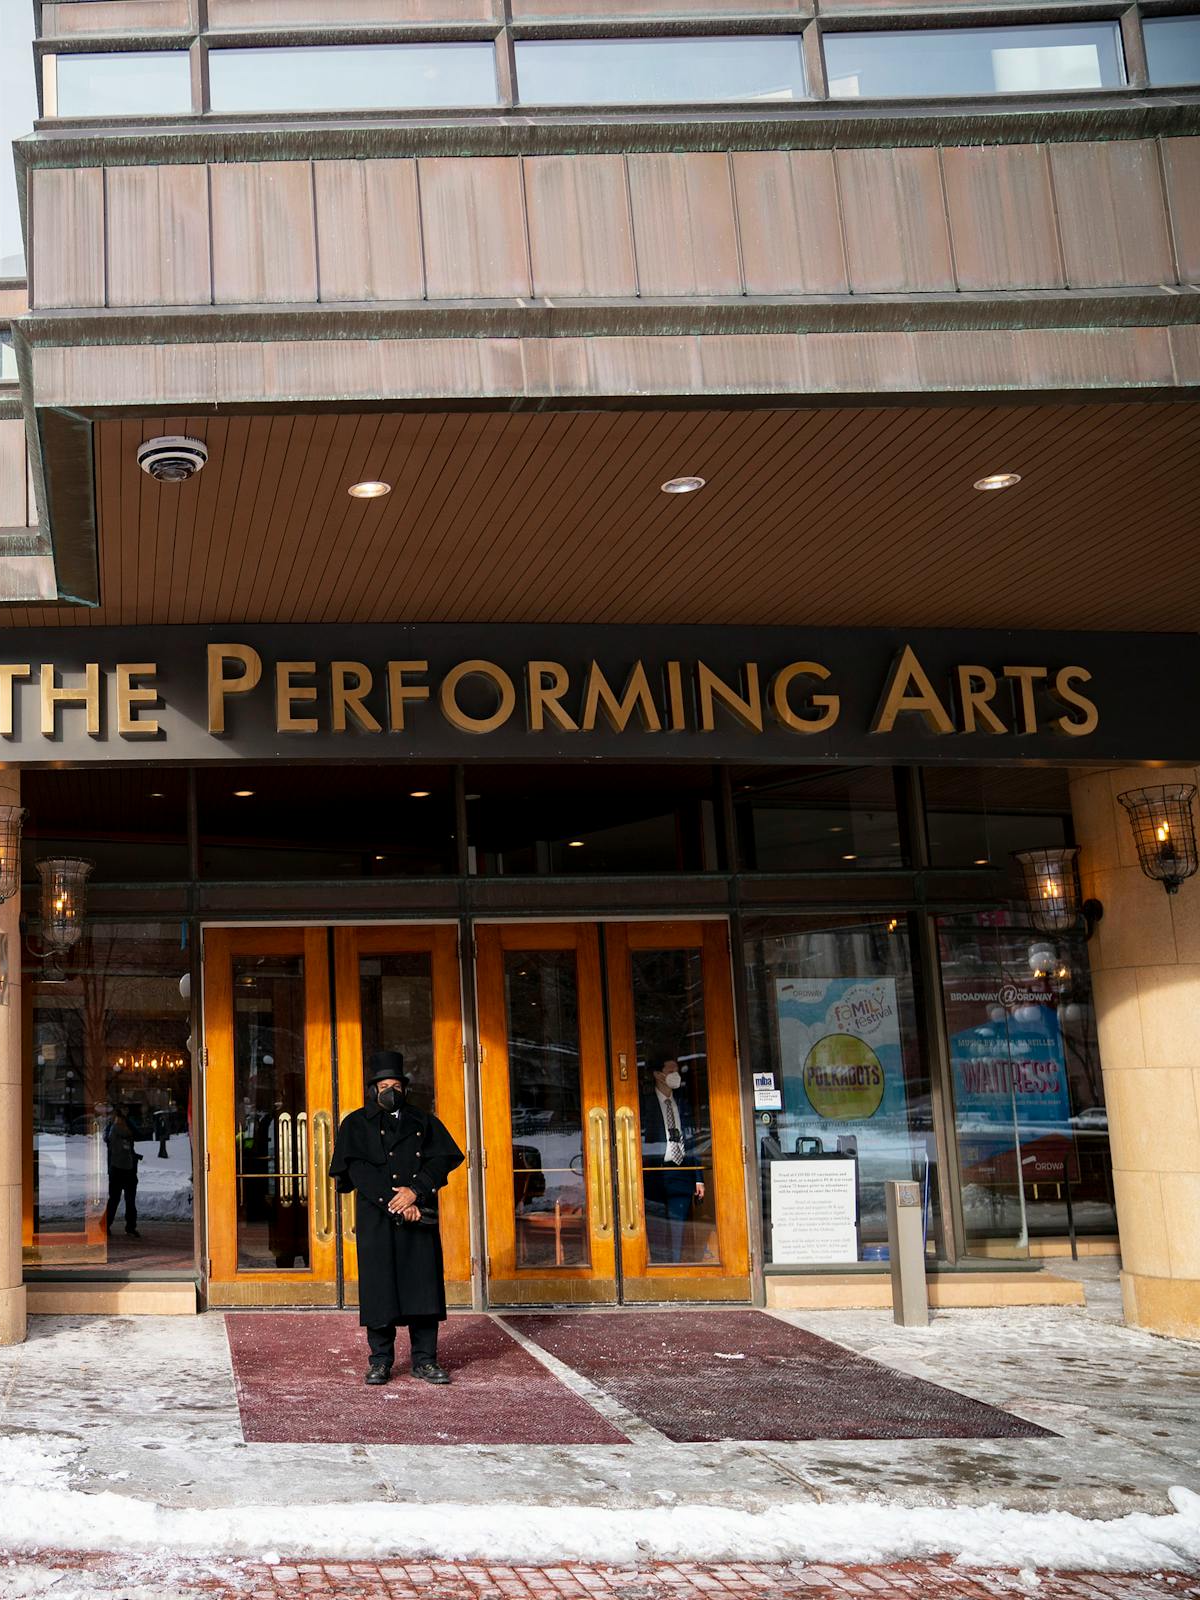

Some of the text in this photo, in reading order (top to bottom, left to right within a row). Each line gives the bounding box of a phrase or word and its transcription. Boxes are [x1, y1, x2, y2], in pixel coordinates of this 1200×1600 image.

[207, 643, 841, 735] PERFORMING
[869, 643, 1099, 737] ARTS
[950, 992, 1000, 1001] BROADWAY
[1017, 993, 1053, 1001] ORDWAY
[807, 1065, 881, 1087] POLKADOTS
[961, 1059, 1060, 1094] WAITRESS
[1035, 1162, 1065, 1171] ORDWA
